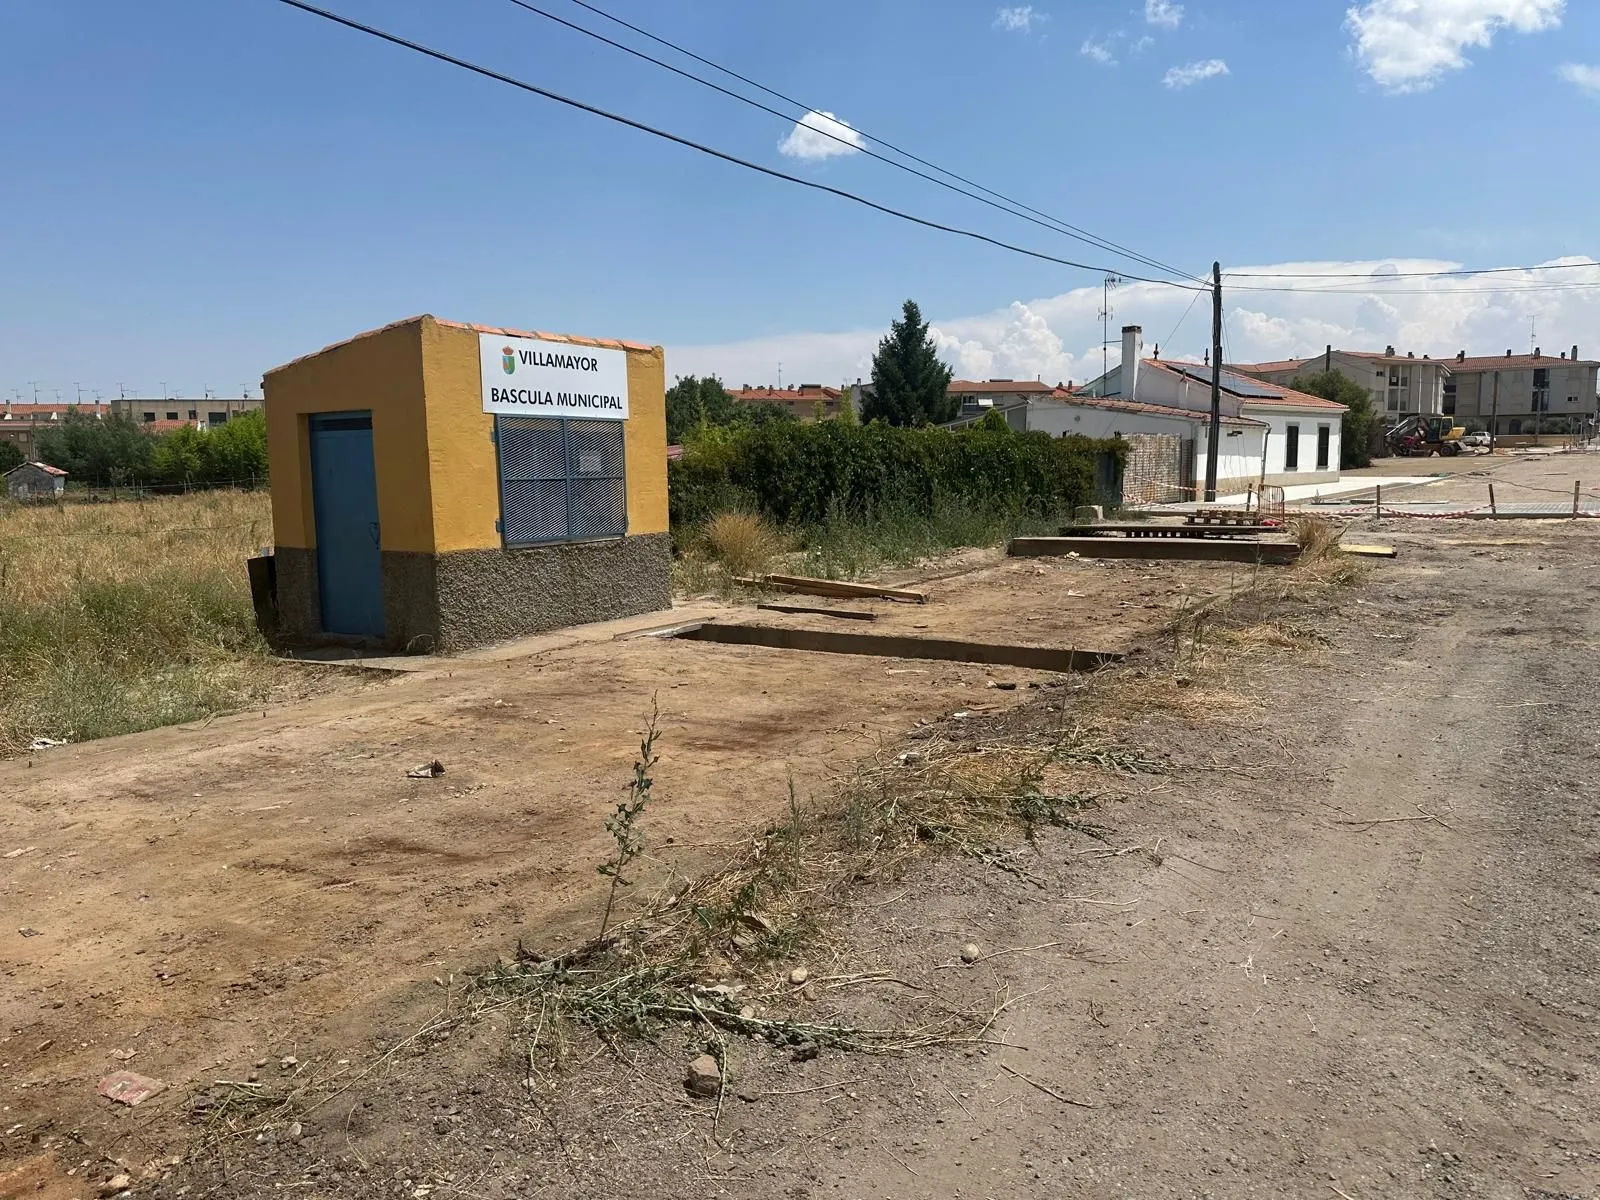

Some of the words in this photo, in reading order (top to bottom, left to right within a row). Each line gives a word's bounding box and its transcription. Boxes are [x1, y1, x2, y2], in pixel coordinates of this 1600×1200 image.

[518, 350, 598, 372] VILLAMAYOR
[491, 387, 553, 406] BASCULA
[557, 392, 623, 410] MUNICIPAL
